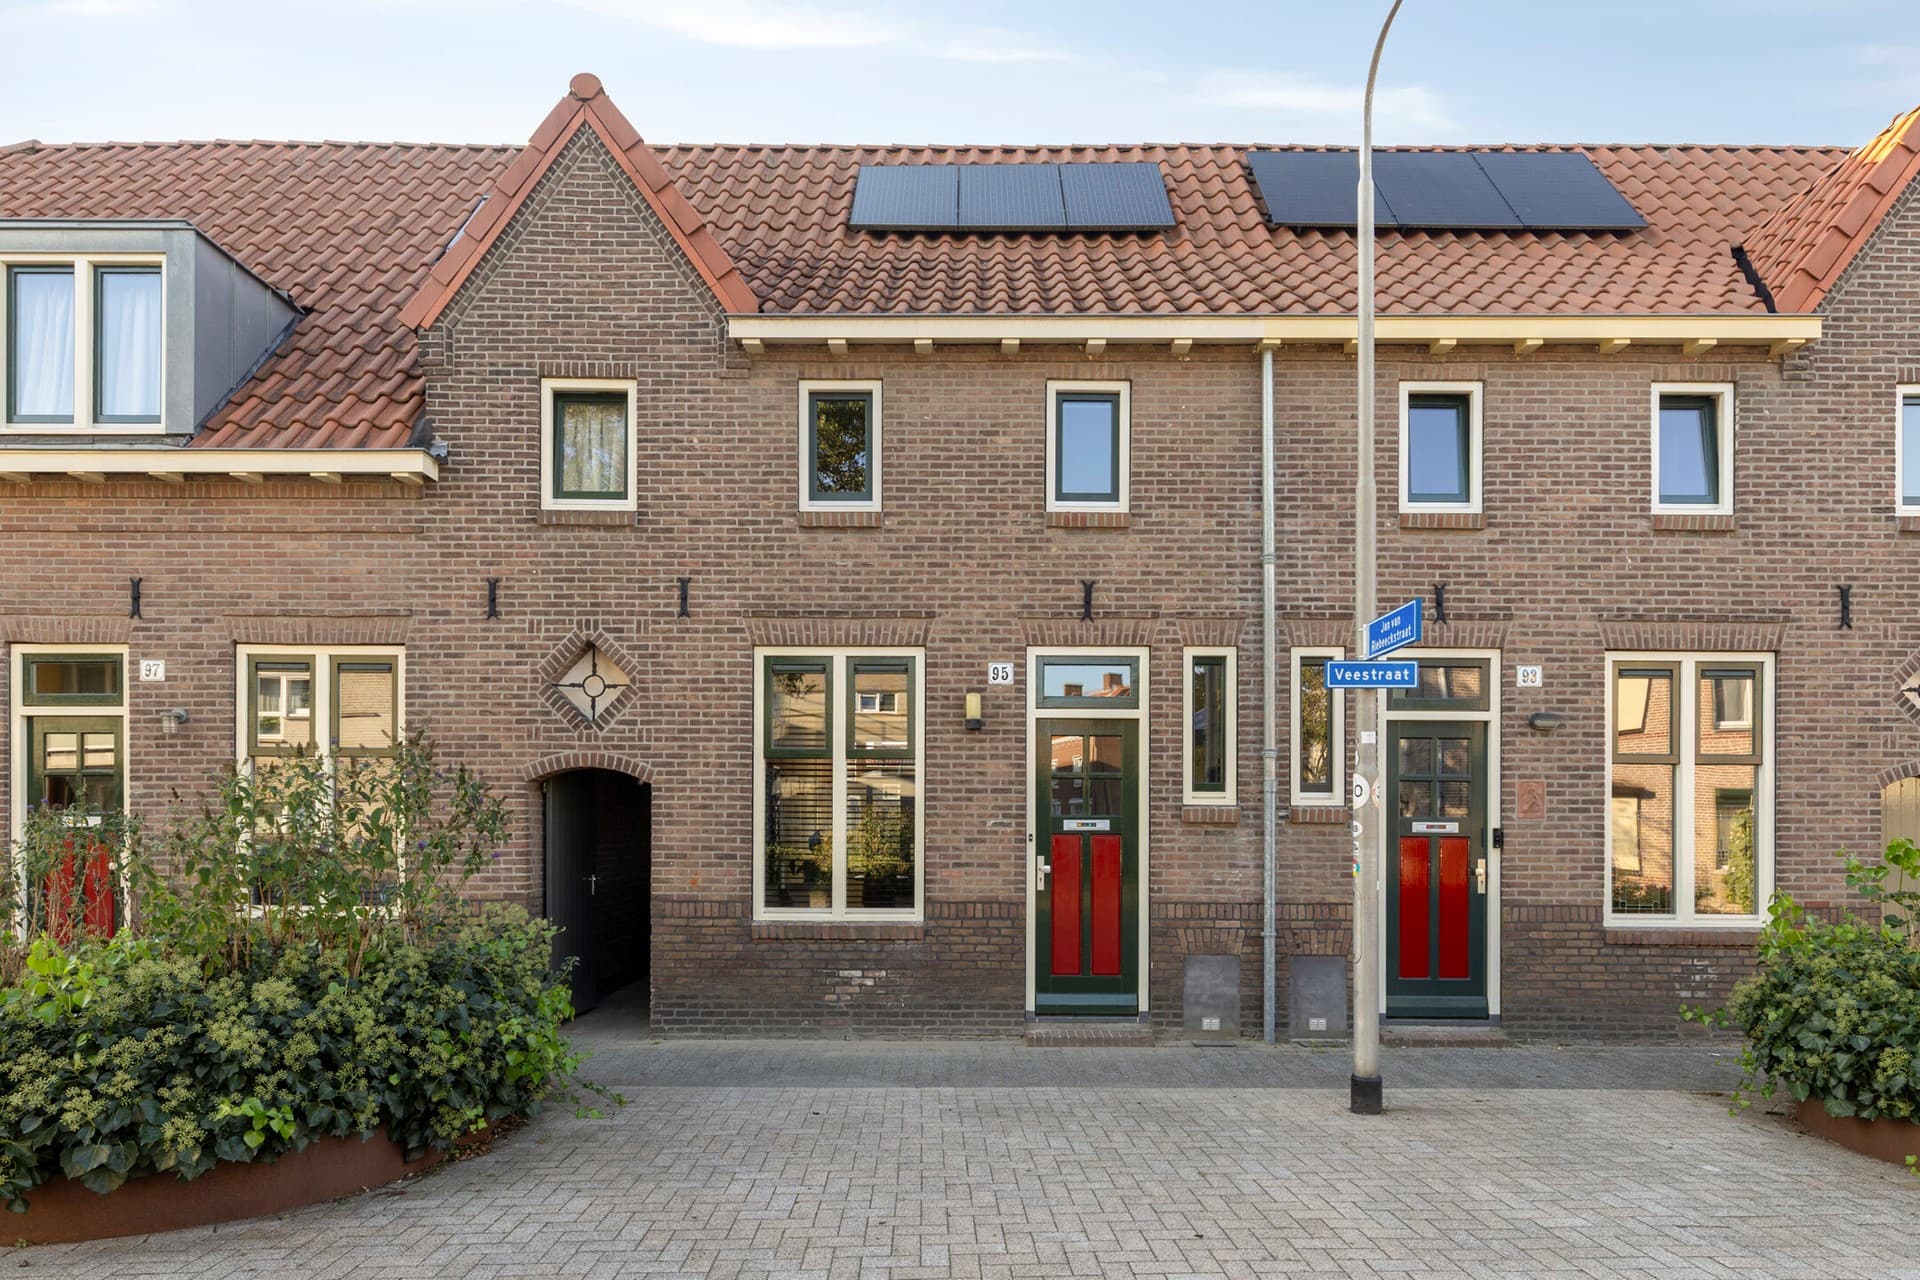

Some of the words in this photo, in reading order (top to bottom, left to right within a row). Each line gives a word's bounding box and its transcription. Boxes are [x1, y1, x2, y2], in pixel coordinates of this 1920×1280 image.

[1380, 619, 1390, 633] Jan
[1391, 616, 1401, 628] van
[1371, 624, 1412, 651] Riebeeckstraat
[145, 663, 160, 677] 97
[992, 666, 1008, 680] 95
[1334, 668, 1409, 681] Veestraat
[1522, 669, 1537, 683] 93
